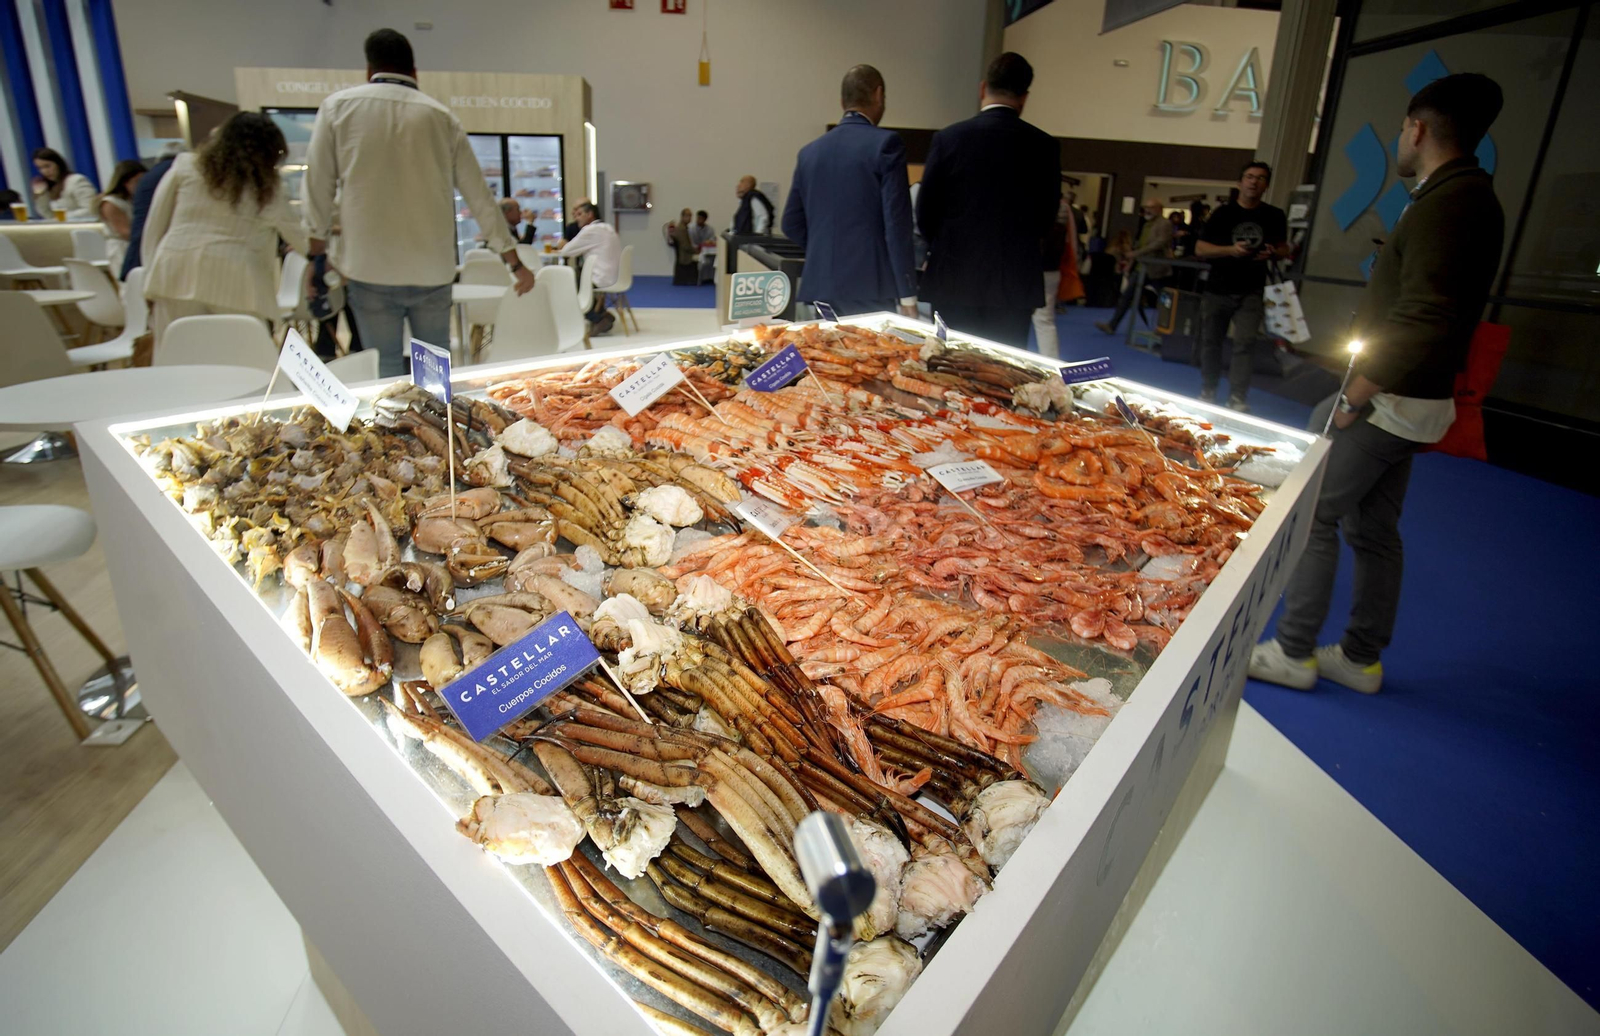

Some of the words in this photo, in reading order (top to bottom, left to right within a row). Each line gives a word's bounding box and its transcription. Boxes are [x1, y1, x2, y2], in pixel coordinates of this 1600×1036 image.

[1153, 40, 1265, 121] BA
[500, 97, 552, 109] COCIDO
[736, 276, 765, 295] asc
[289, 344, 347, 405] CASTELLAR
[619, 361, 672, 398] CASTELLAR
[751, 352, 796, 386] CASTELLAR
[1061, 363, 1109, 375] CASTELLAR
[460, 625, 571, 702] CASTELLAR
[491, 687, 501, 695] EL
[501, 671, 525, 689] SABOR
[524, 661, 538, 673] DEL
[538, 651, 553, 664] MAR
[498, 687, 534, 713] Cuerpos
[533, 664, 567, 690] Cocidos
